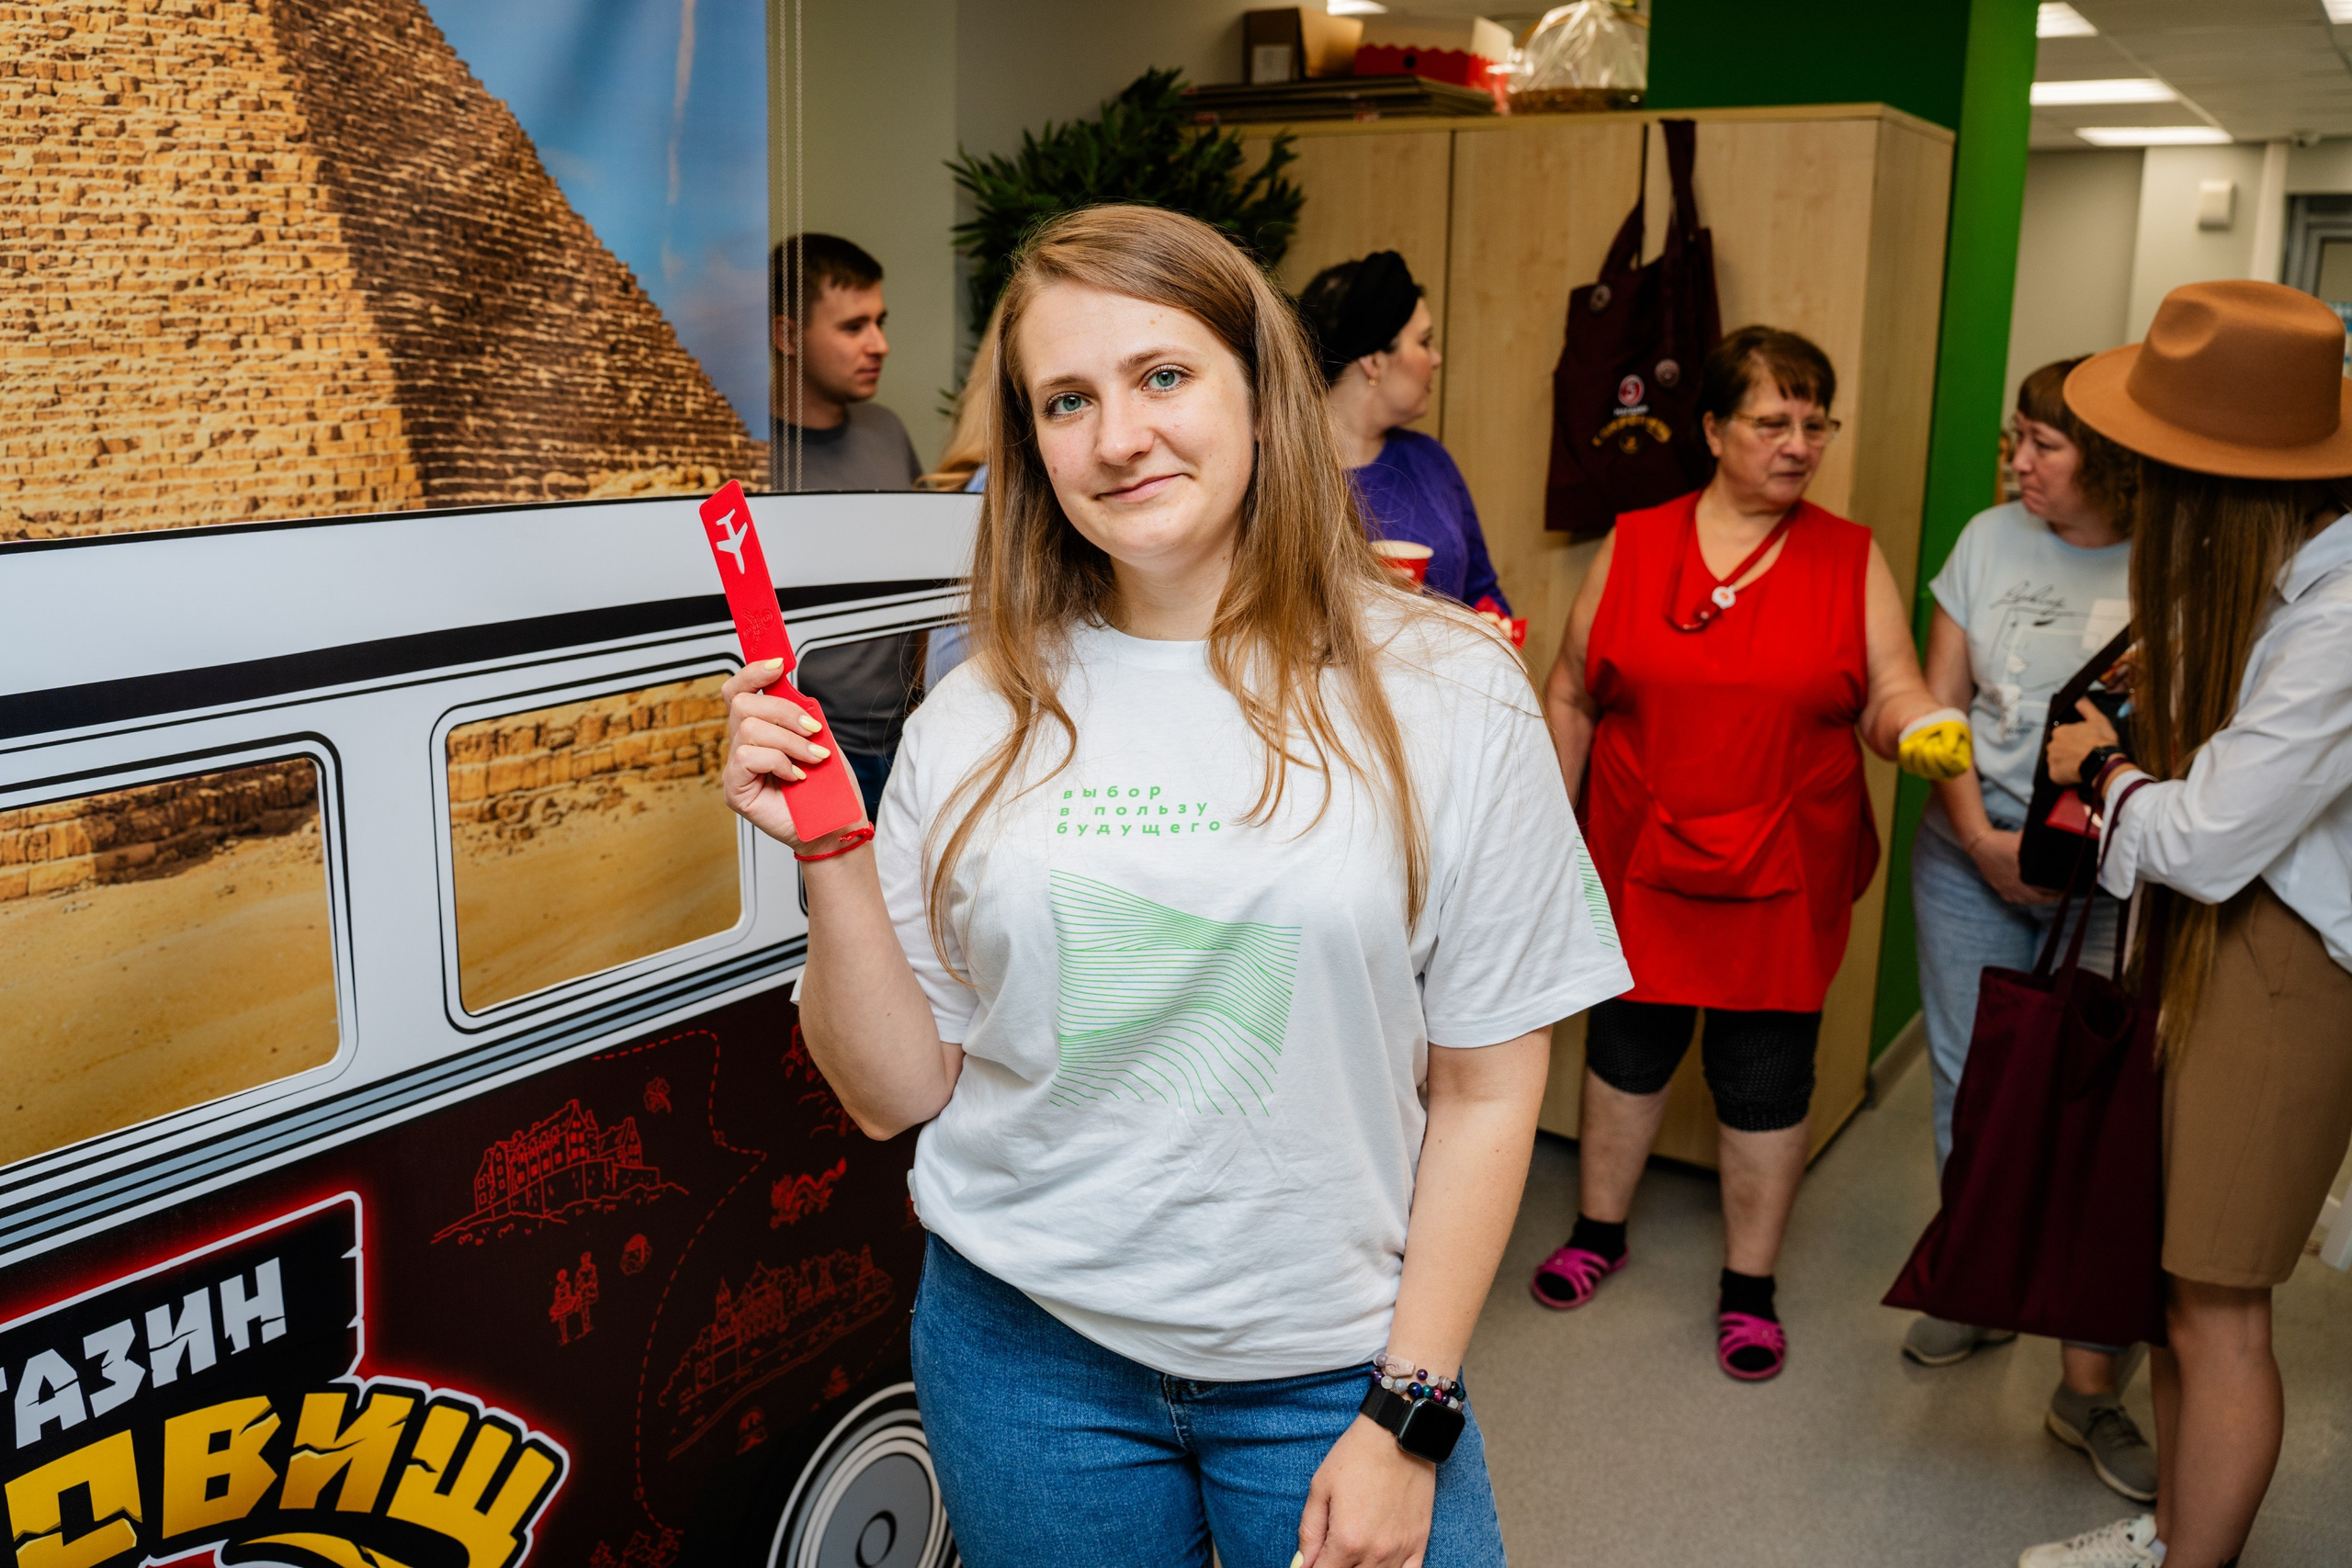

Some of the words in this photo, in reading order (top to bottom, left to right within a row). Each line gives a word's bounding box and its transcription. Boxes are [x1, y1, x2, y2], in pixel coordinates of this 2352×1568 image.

[1063, 785, 1161, 800] выбор
[1059, 807, 1070, 817] в
[1093, 802, 1208, 817] пользу
[1056, 820, 1221, 836] будущего
[0, 1257, 287, 1450] АЗИН
